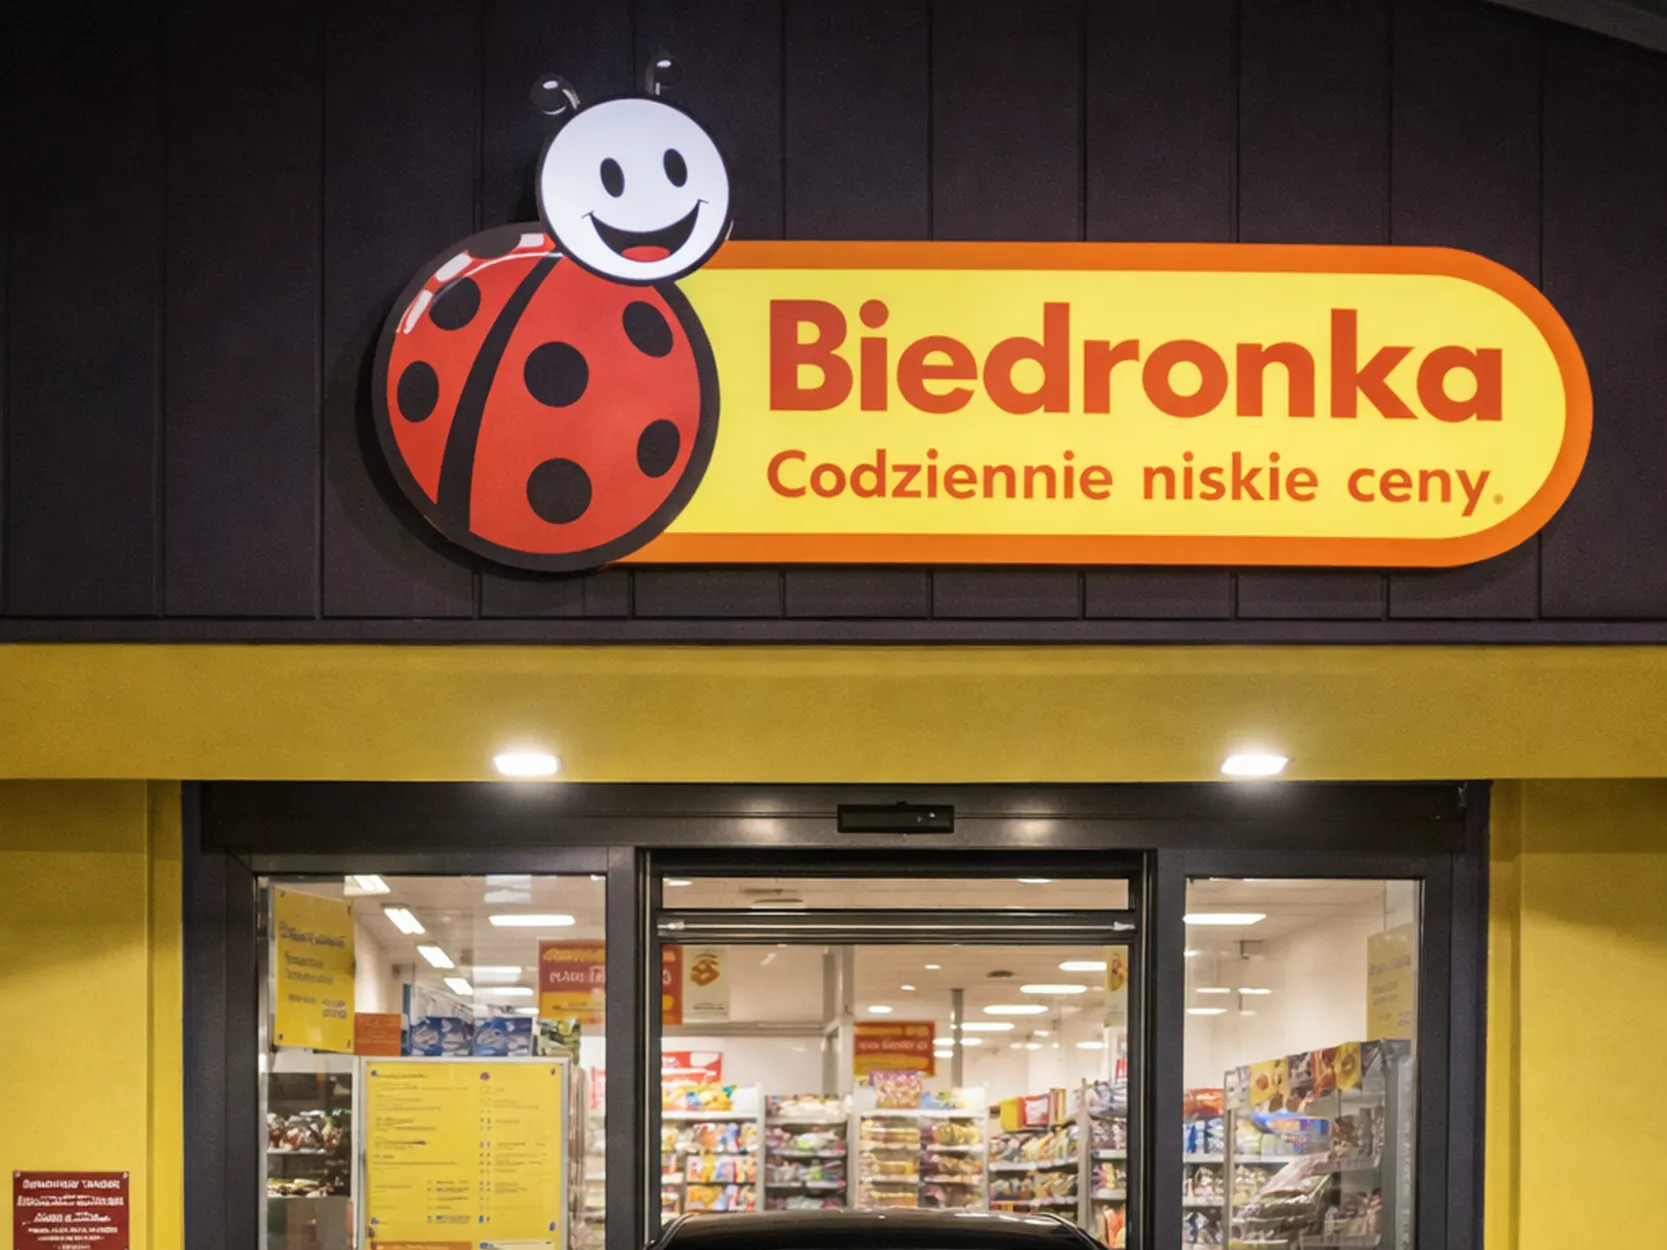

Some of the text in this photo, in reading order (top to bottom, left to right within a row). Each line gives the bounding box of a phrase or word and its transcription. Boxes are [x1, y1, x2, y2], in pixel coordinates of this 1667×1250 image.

[769, 299, 1503, 423] Biedronka
[767, 449, 1112, 500] Codziennie
[1144, 452, 1318, 501] niskie
